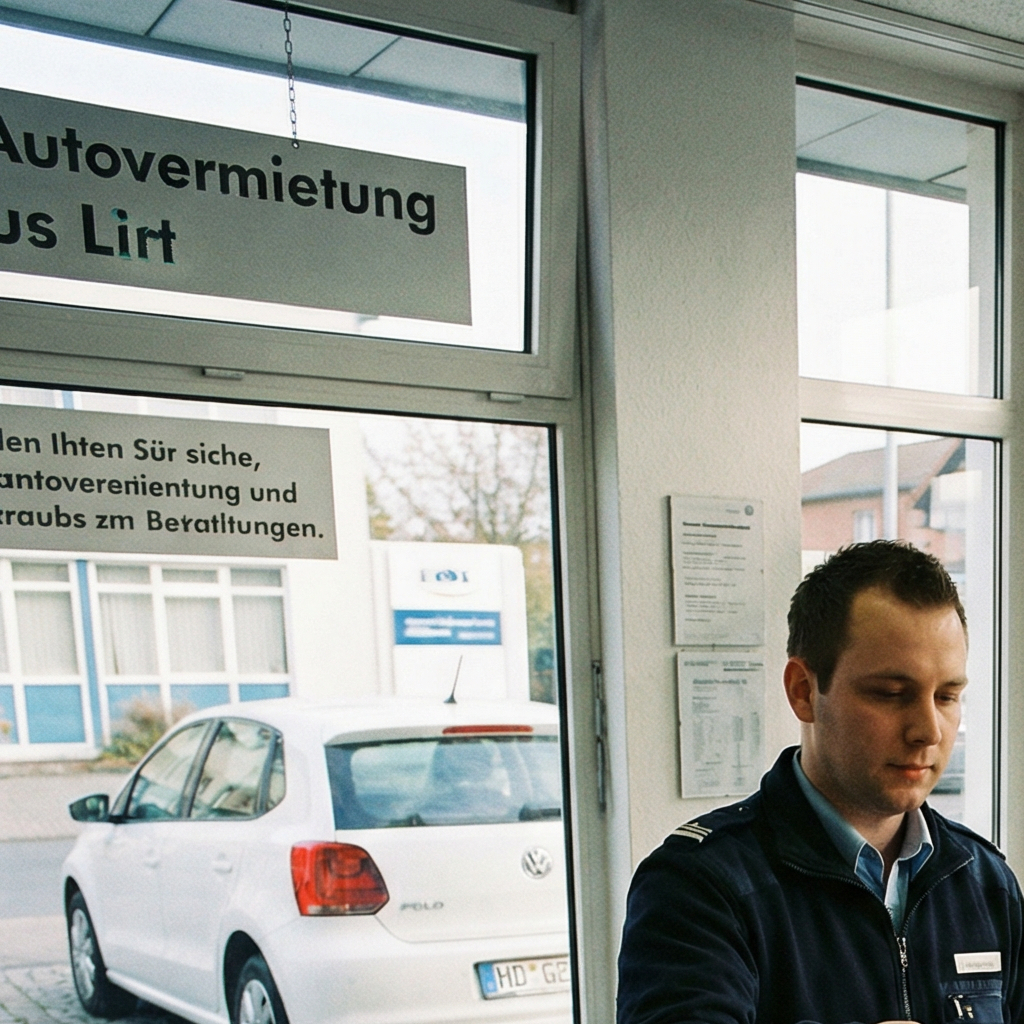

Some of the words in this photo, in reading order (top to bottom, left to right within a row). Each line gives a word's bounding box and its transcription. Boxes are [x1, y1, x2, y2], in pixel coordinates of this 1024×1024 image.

[133, 438, 177, 462] Sür
[186, 442, 260, 472] siche,
[250, 482, 297, 503] und
[95, 514, 134, 530] zm
[496, 964, 527, 988] HD
